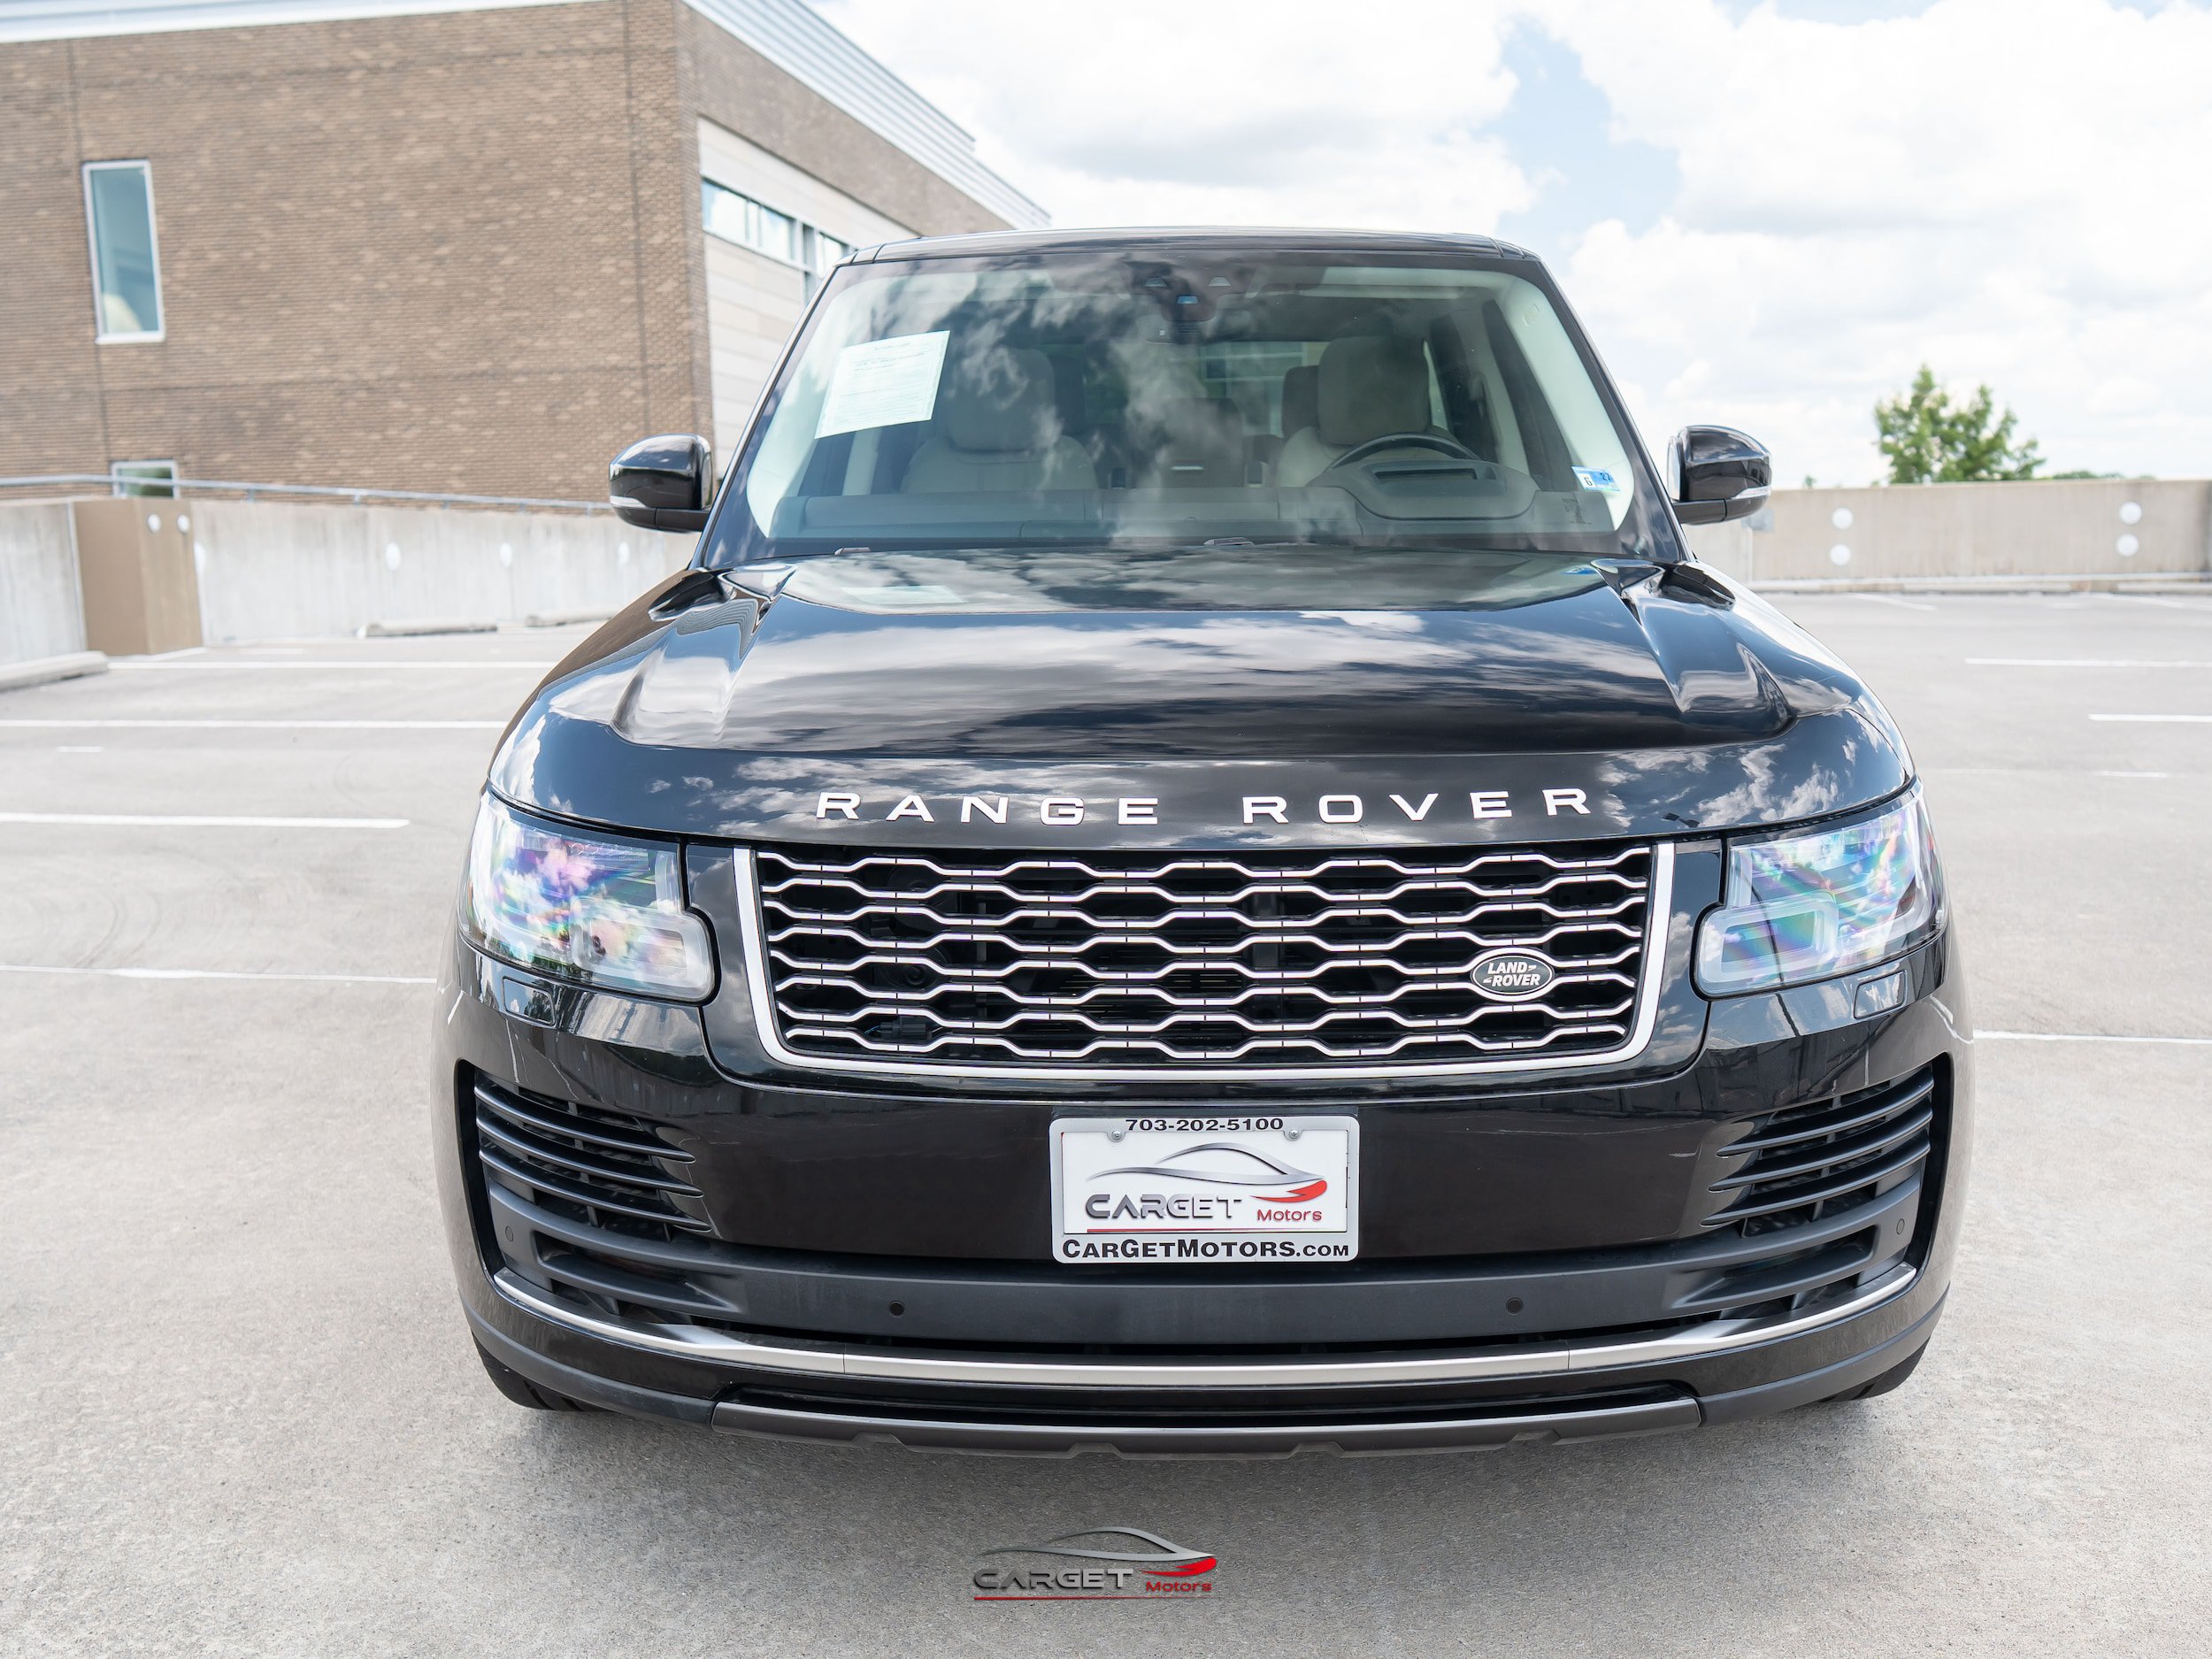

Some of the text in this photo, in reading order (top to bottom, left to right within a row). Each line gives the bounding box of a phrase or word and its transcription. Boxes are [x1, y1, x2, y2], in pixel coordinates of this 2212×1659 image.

[816, 788, 1591, 825] RANGE ROVER
[1487, 961, 1528, 974] LAND
[1491, 973, 1540, 987] ROVER
[1125, 1118, 1284, 1132] 703-202-5100
[1086, 1193, 1322, 1222] CARGET Motors
